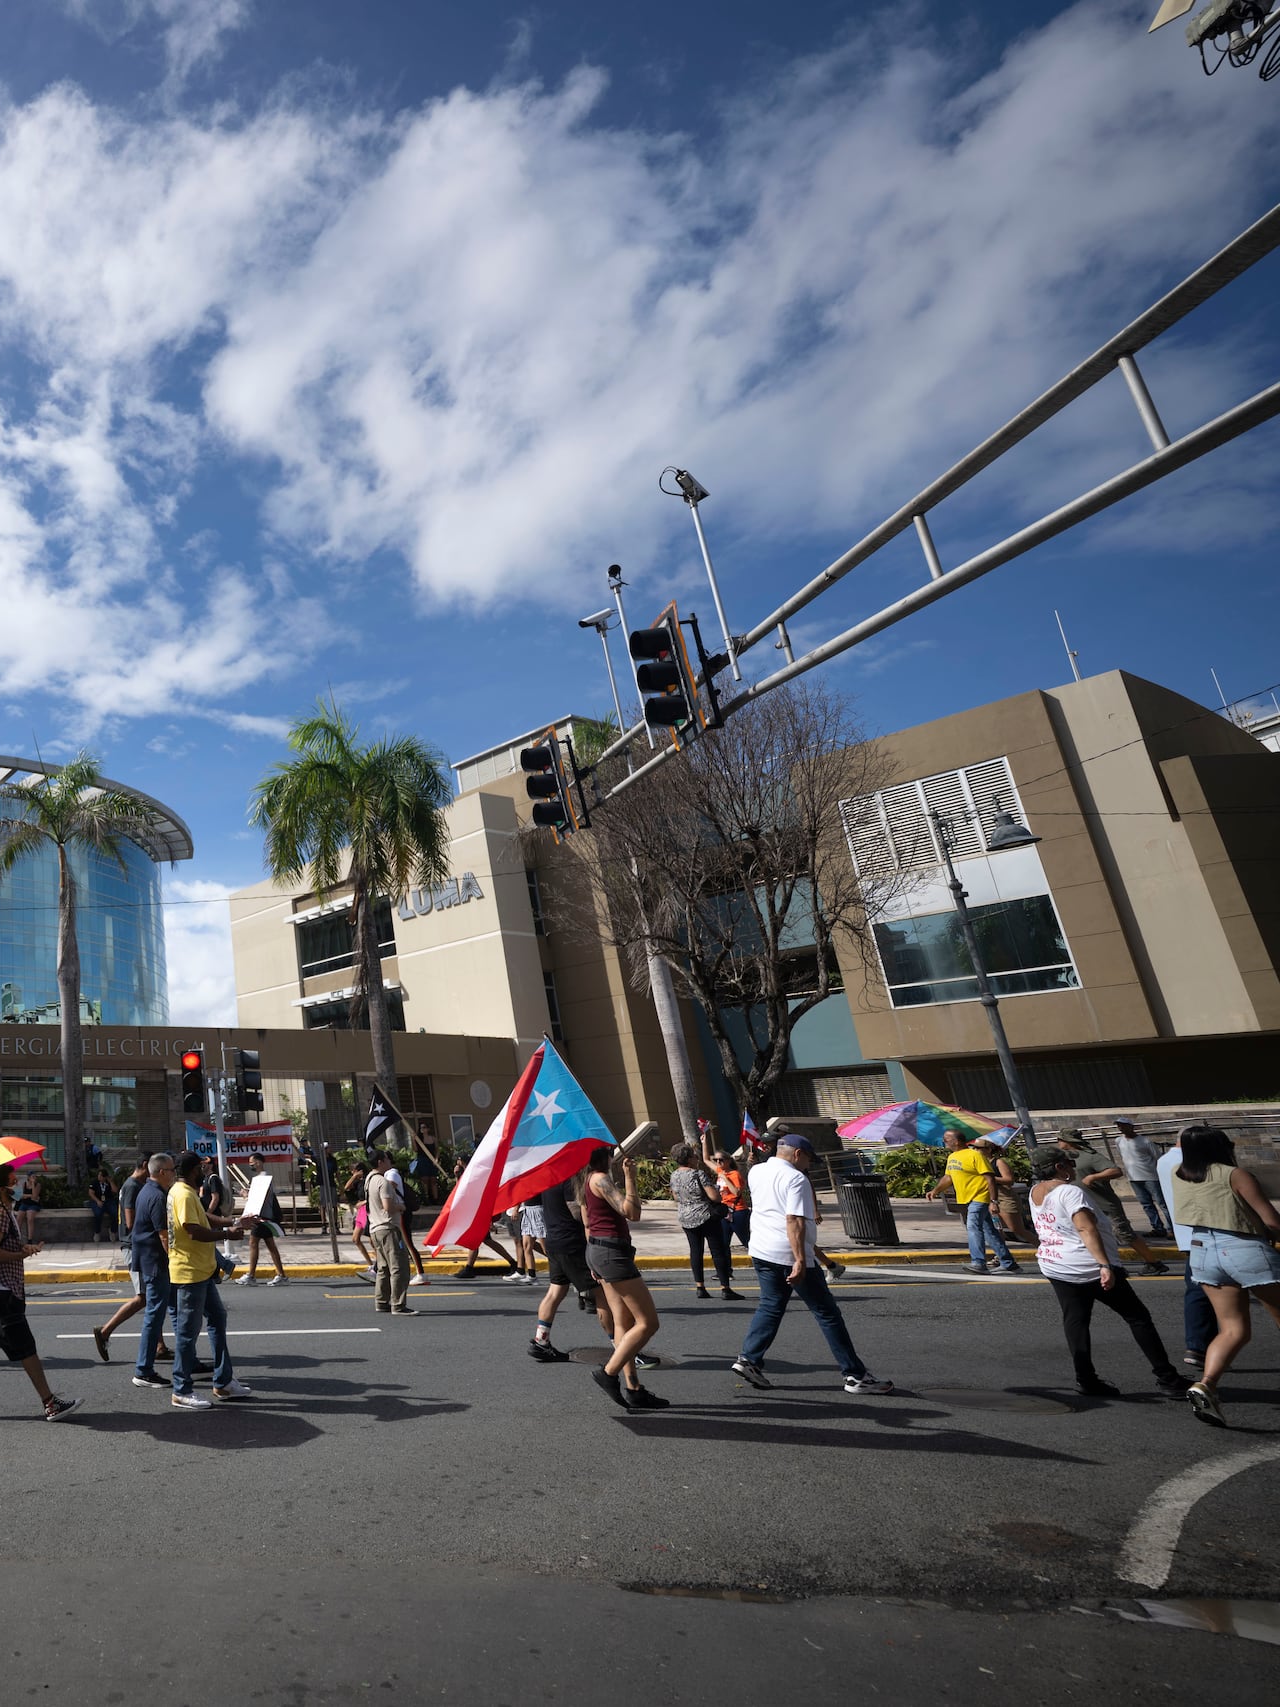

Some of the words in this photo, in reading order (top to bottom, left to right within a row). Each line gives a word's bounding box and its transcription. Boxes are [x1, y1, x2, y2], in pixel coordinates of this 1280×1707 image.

[398, 872, 484, 921] LUMA
[193, 1142, 213, 1154] POR
[215, 1140, 258, 1153] UERTO
[261, 1140, 291, 1153] RICO,
